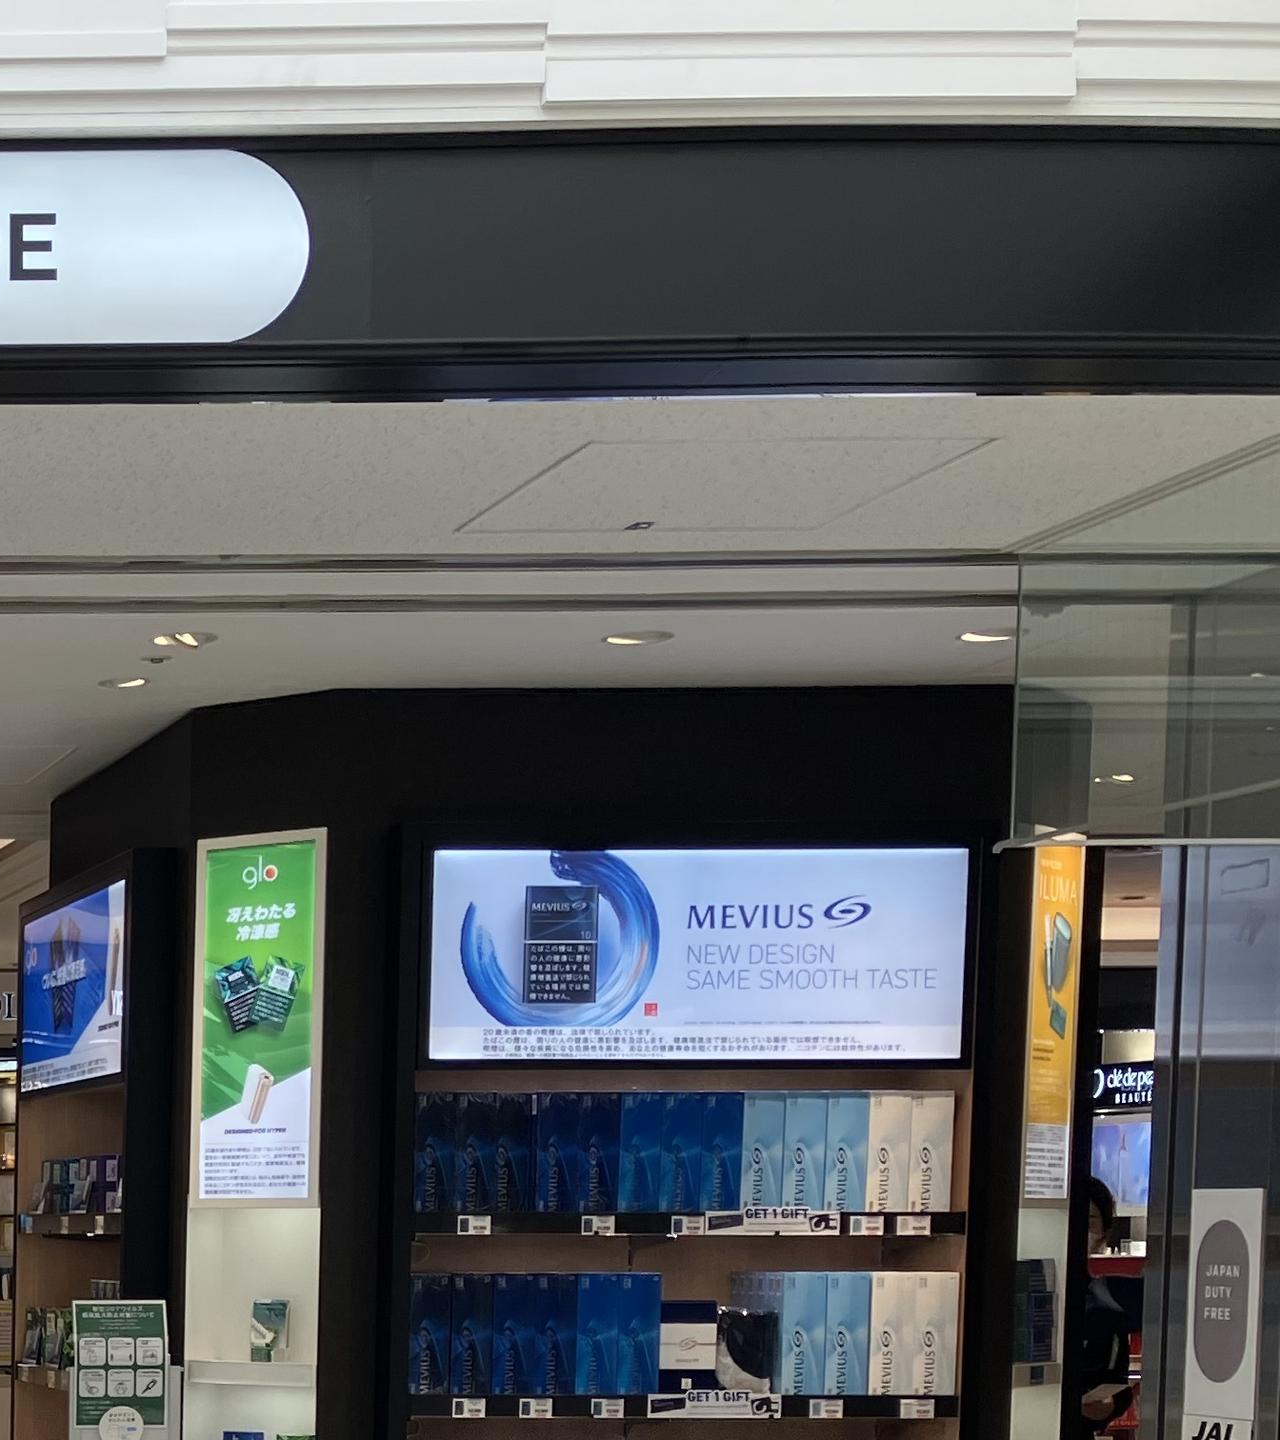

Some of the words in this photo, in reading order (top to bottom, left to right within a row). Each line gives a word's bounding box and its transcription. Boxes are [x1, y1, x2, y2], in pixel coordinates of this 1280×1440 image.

[242, 855, 278, 890] glo
[1040, 874, 1077, 905] ILUMA
[225, 902, 297, 924] 冴えわたる
[531, 902, 571, 912] MEVIUS
[687, 904, 814, 929] MEVIUS
[580, 930, 591, 940] 10
[687, 944, 740, 965] NEW
[748, 944, 835, 965] DESIGN
[687, 969, 751, 990] SAME
[759, 969, 858, 990] SMOOTH
[866, 968, 938, 990] TASTE
[836, 1167, 848, 1212] MEVIUS
[878, 1167, 890, 1213] MEVIUS
[920, 1167, 933, 1213] MEVIUS
[745, 1208, 771, 1219] GET
[773, 1208, 778, 1218] 1
[780, 1208, 809, 1218] GIFT
[1206, 1264, 1240, 1278] JAPAN
[1205, 1285, 1232, 1299] DUTY
[1204, 1307, 1231, 1321] FREE
[793, 1350, 805, 1395] MEVIUS
[836, 1350, 848, 1395] MEVIUS
[880, 1350, 893, 1396] MEVIUS
[924, 1350, 936, 1396] MEVIUS
[687, 1391, 712, 1402] GET
[715, 1391, 720, 1401] 1
[723, 1391, 751, 1401] GIFT
